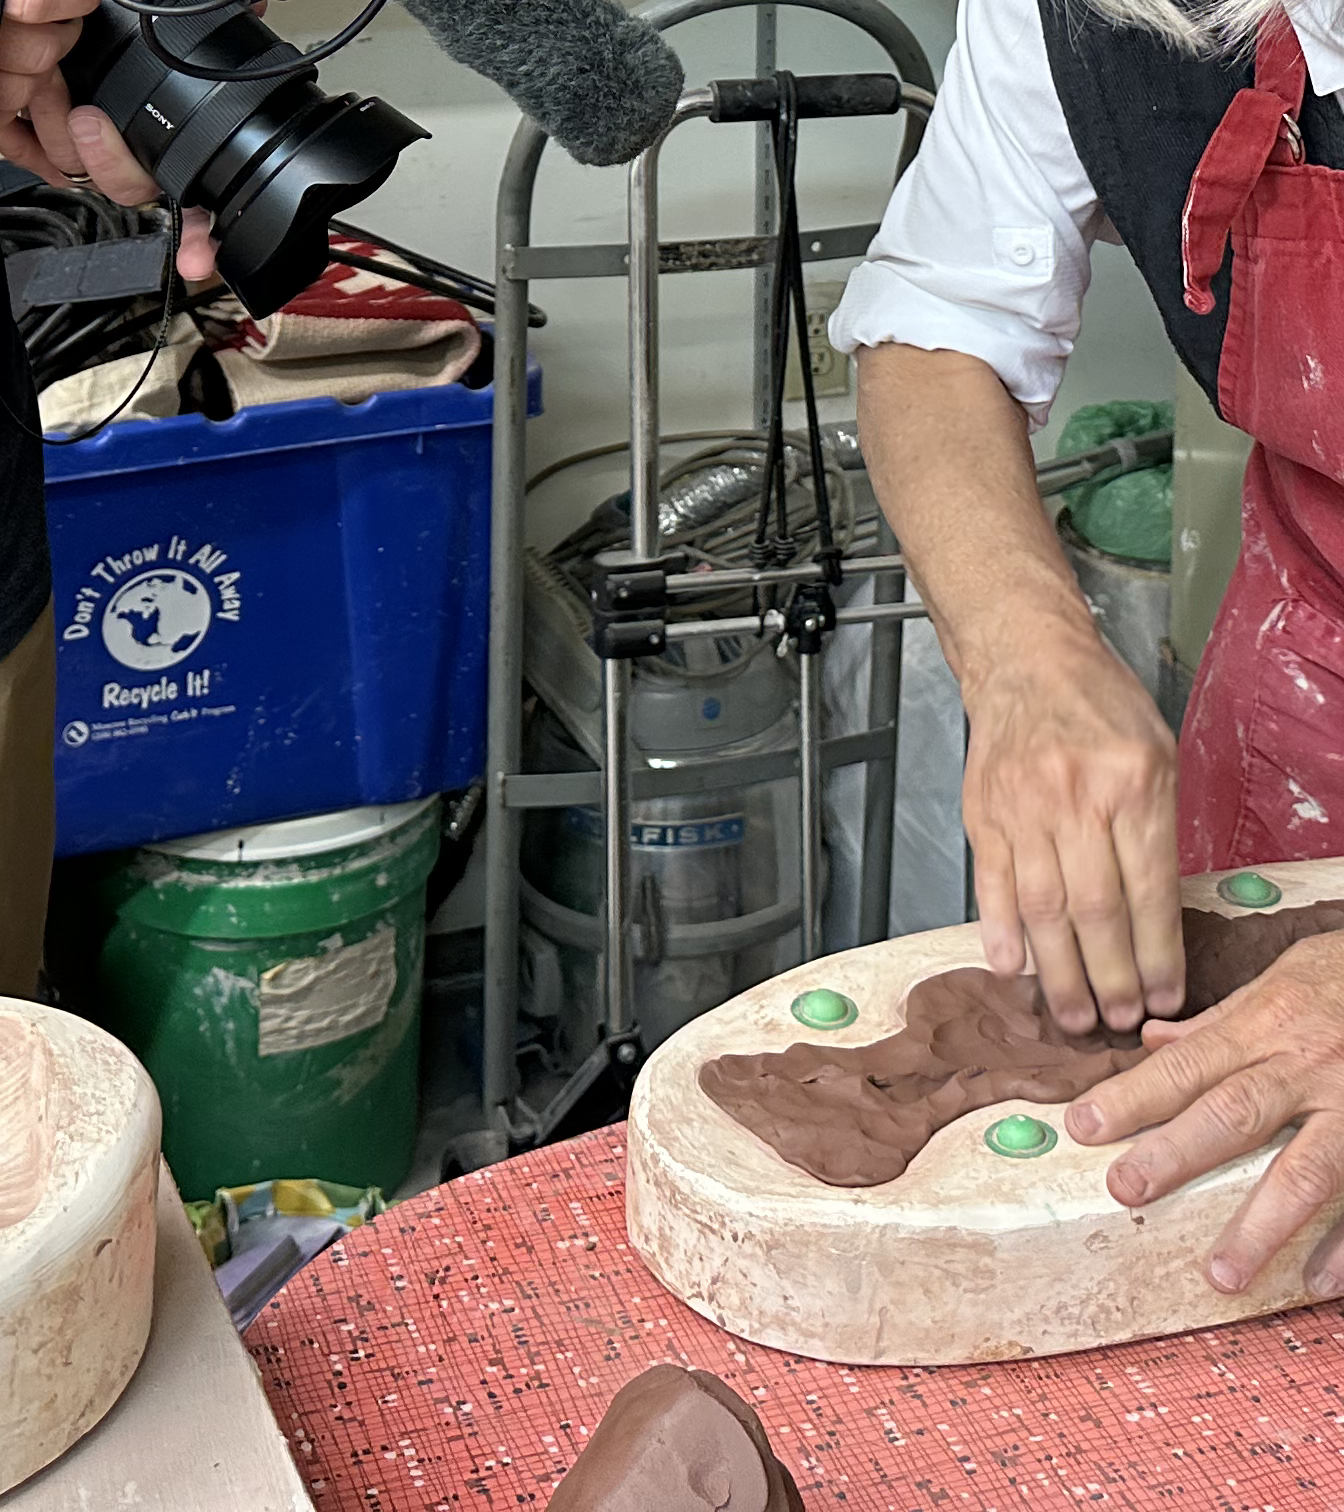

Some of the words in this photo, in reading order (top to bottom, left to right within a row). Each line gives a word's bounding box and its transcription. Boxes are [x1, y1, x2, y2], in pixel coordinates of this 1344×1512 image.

[144, 102, 175, 130] SONY
[63, 587, 101, 640] Don't
[90, 543, 159, 583] Throw
[167, 535, 187, 561] It
[188, 543, 228, 573] All
[213, 571, 241, 621] Away
[102, 676, 178, 709] Recycle
[186, 669, 210, 697] It!
[631, 824, 725, 845] FISK
